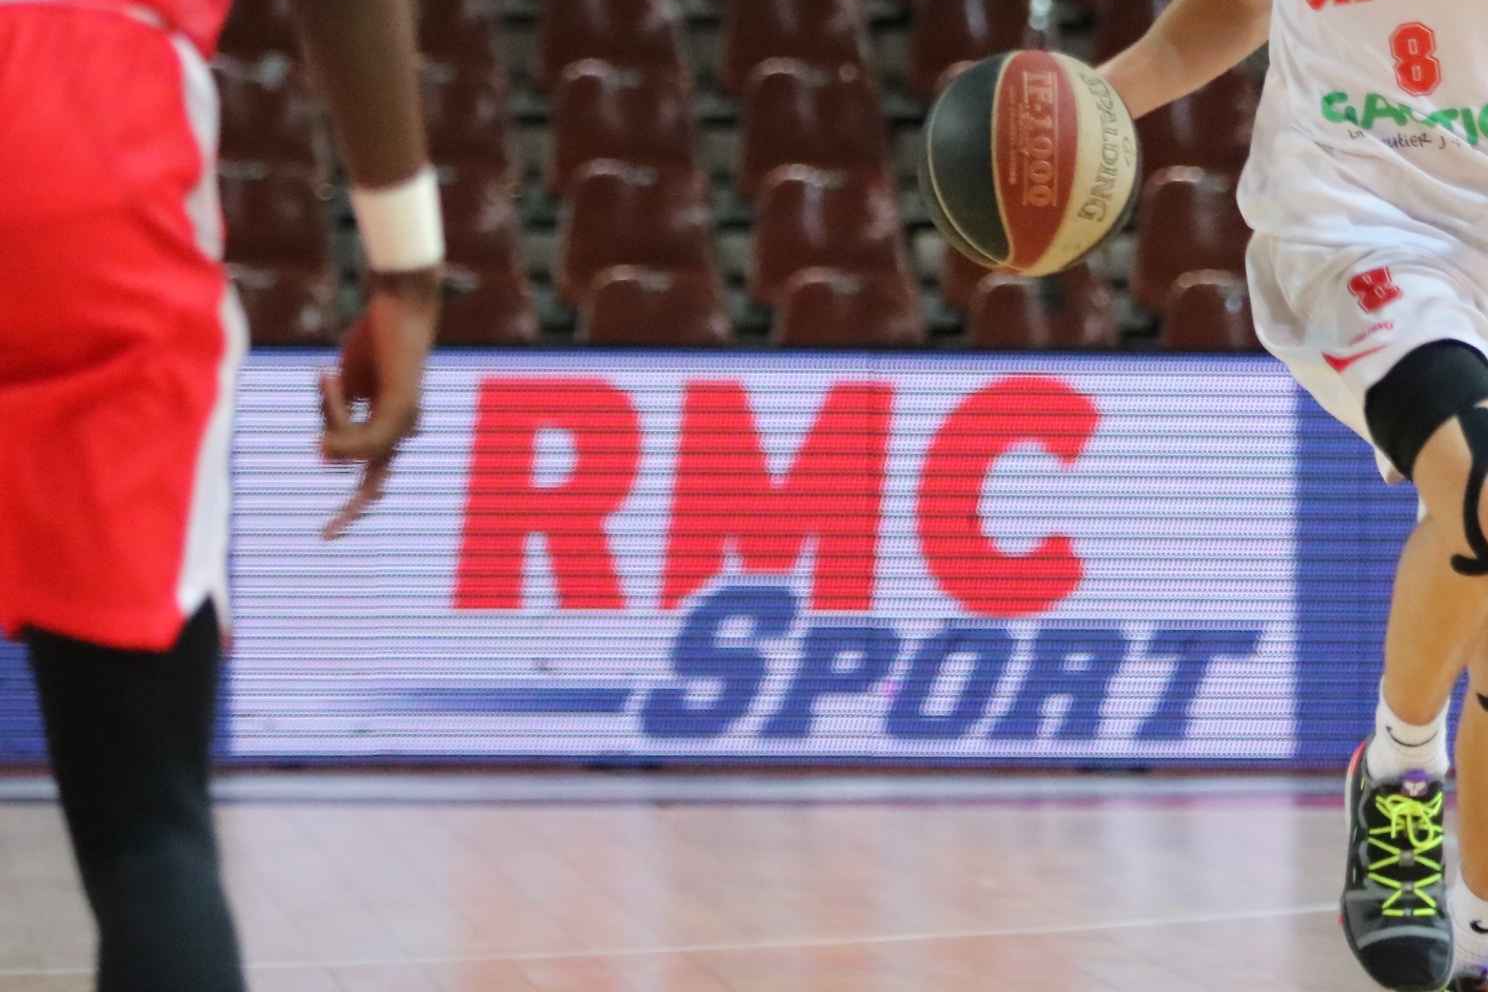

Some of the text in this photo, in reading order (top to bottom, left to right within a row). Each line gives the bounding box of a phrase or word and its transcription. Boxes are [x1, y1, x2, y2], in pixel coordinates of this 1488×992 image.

[1389, 21, 1442, 97] 8
[1027, 72, 1053, 207] TF-1000
[1078, 71, 1120, 223] SPALDING
[453, 374, 1102, 618] RMC
[638, 585, 1260, 739] SPORT
